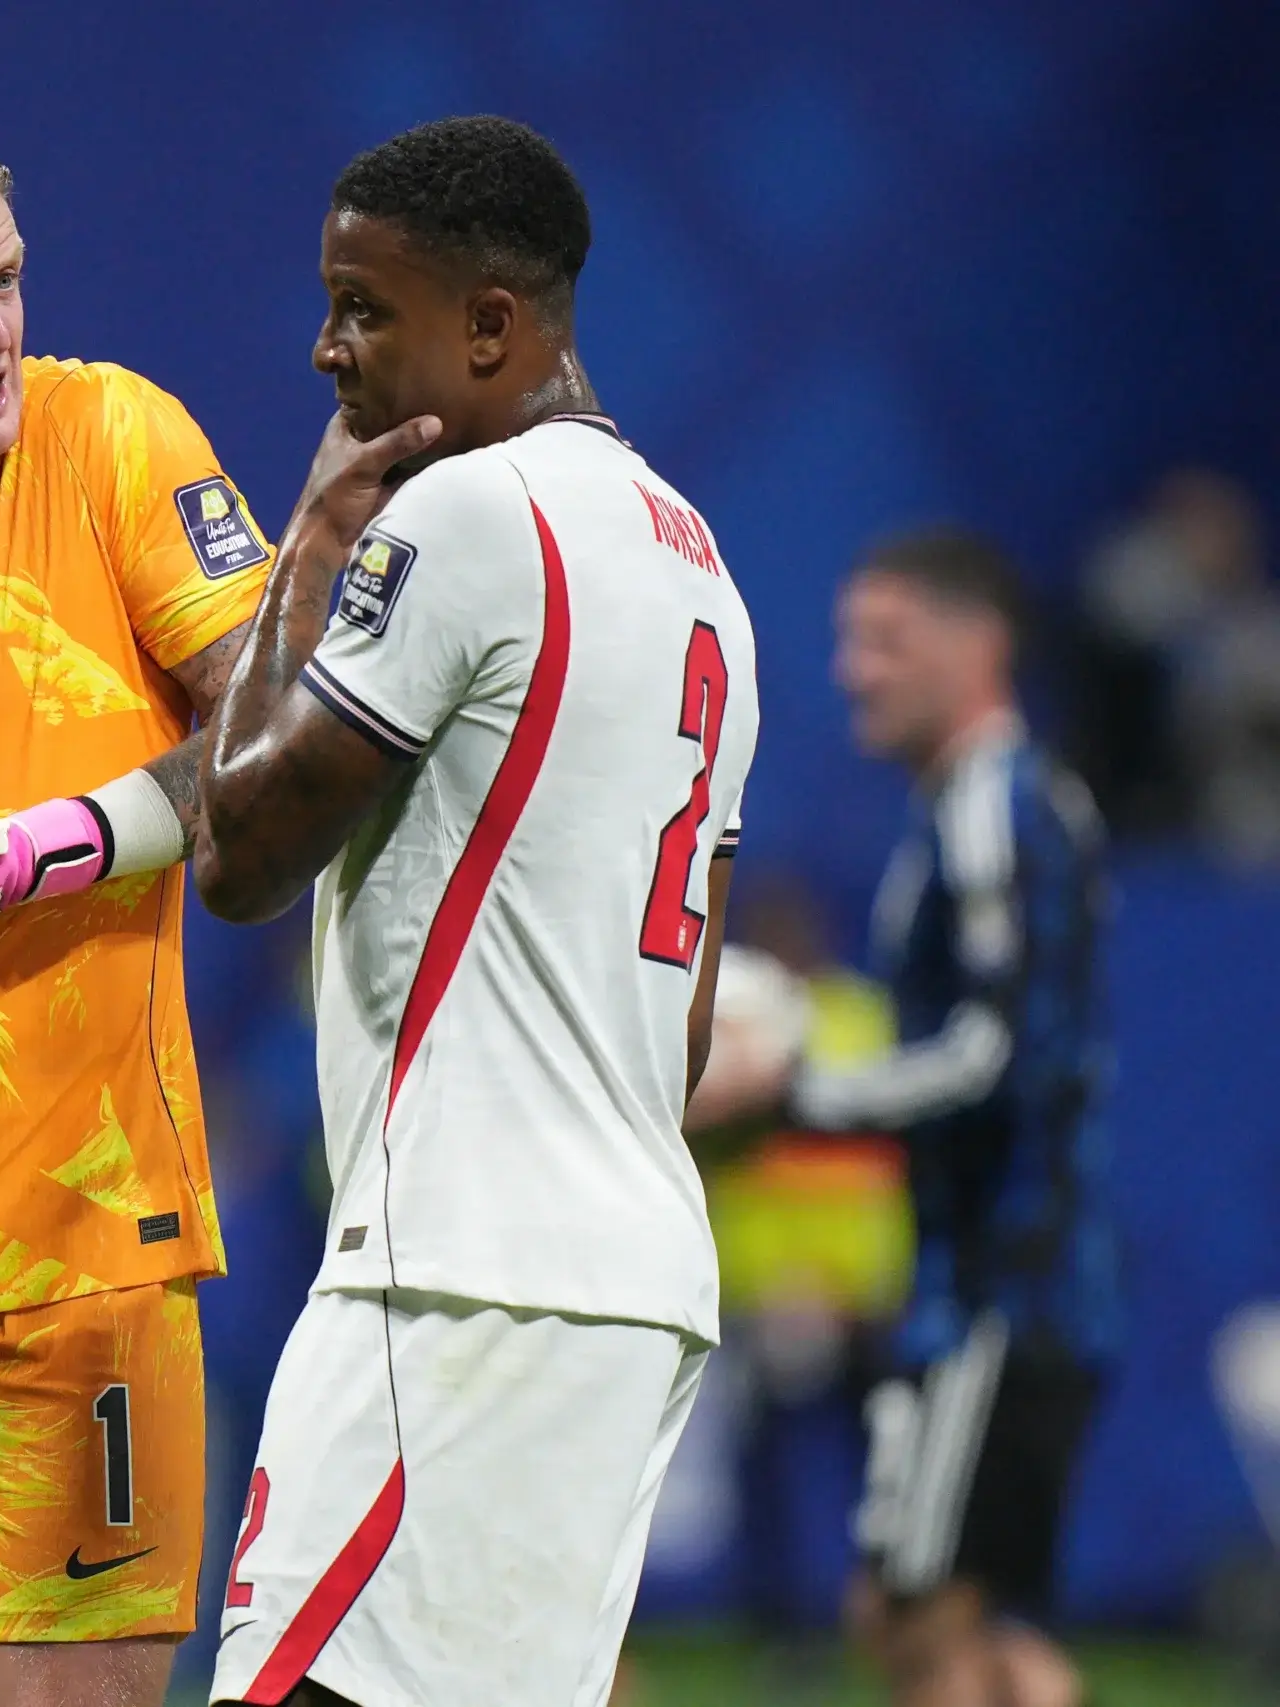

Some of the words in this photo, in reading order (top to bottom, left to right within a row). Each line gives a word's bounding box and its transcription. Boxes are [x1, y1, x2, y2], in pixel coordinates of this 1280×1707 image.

[205, 532, 251, 559] EDUCATION
[639, 618, 728, 976] 2
[93, 1383, 133, 1526] 1
[225, 1466, 270, 1609] 2
